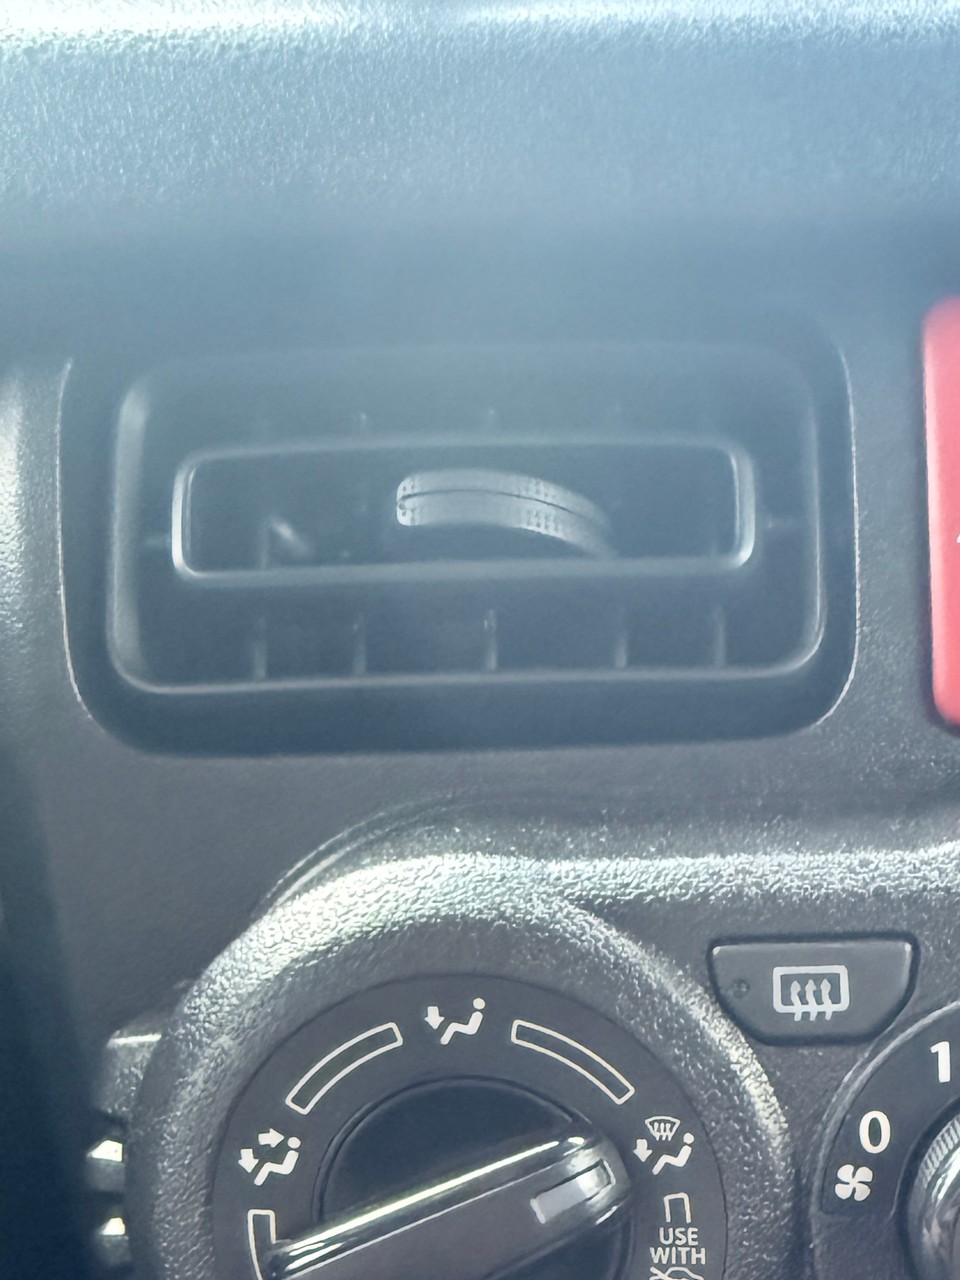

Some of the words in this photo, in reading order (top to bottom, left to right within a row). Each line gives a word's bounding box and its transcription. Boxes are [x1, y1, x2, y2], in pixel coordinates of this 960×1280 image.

[930, 1041, 952, 1083] 1
[858, 1110, 892, 1154] 0
[659, 1227, 699, 1246] USE
[649, 1246, 706, 1265] WITH
